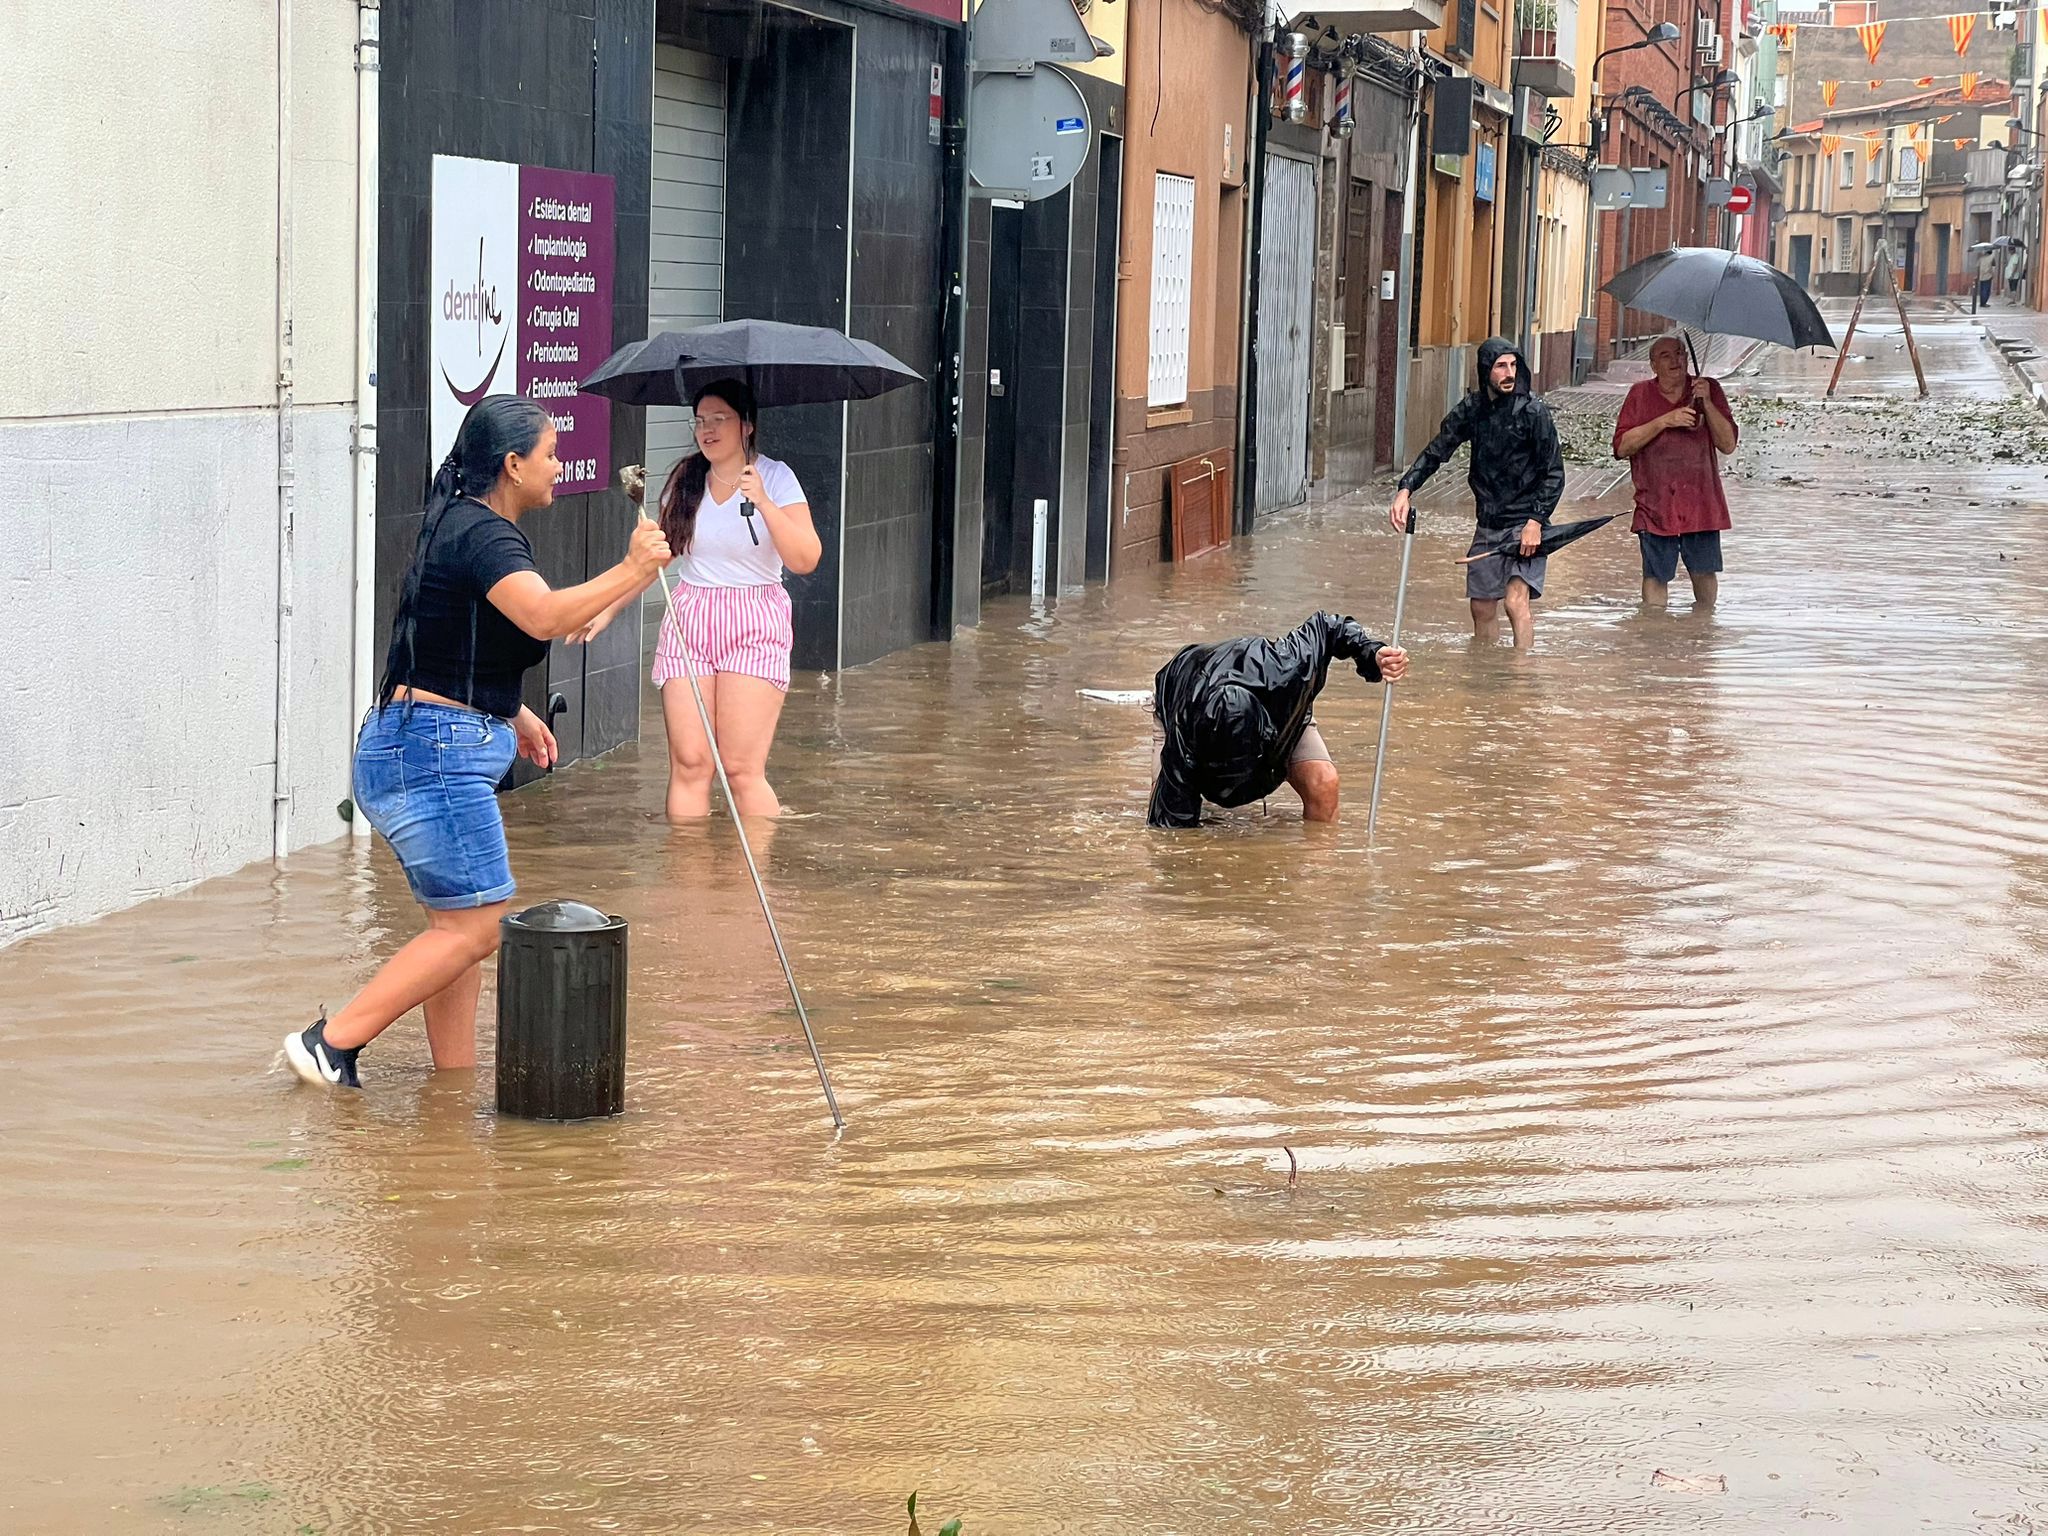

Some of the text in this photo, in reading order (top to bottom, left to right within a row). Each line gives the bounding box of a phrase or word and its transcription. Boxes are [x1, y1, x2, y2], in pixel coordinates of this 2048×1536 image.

[535, 197, 592, 222] Estética dental
[535, 233, 587, 262] Implantología
[534, 269, 595, 297] Odontopediatría
[533, 305, 579, 332] Cirugía Oral
[533, 341, 579, 362] Periodoncia
[532, 376, 578, 399] Endodoncia
[565, 461, 574, 482] 01
[575, 459, 585, 481] 68
[586, 458, 596, 480] 52
